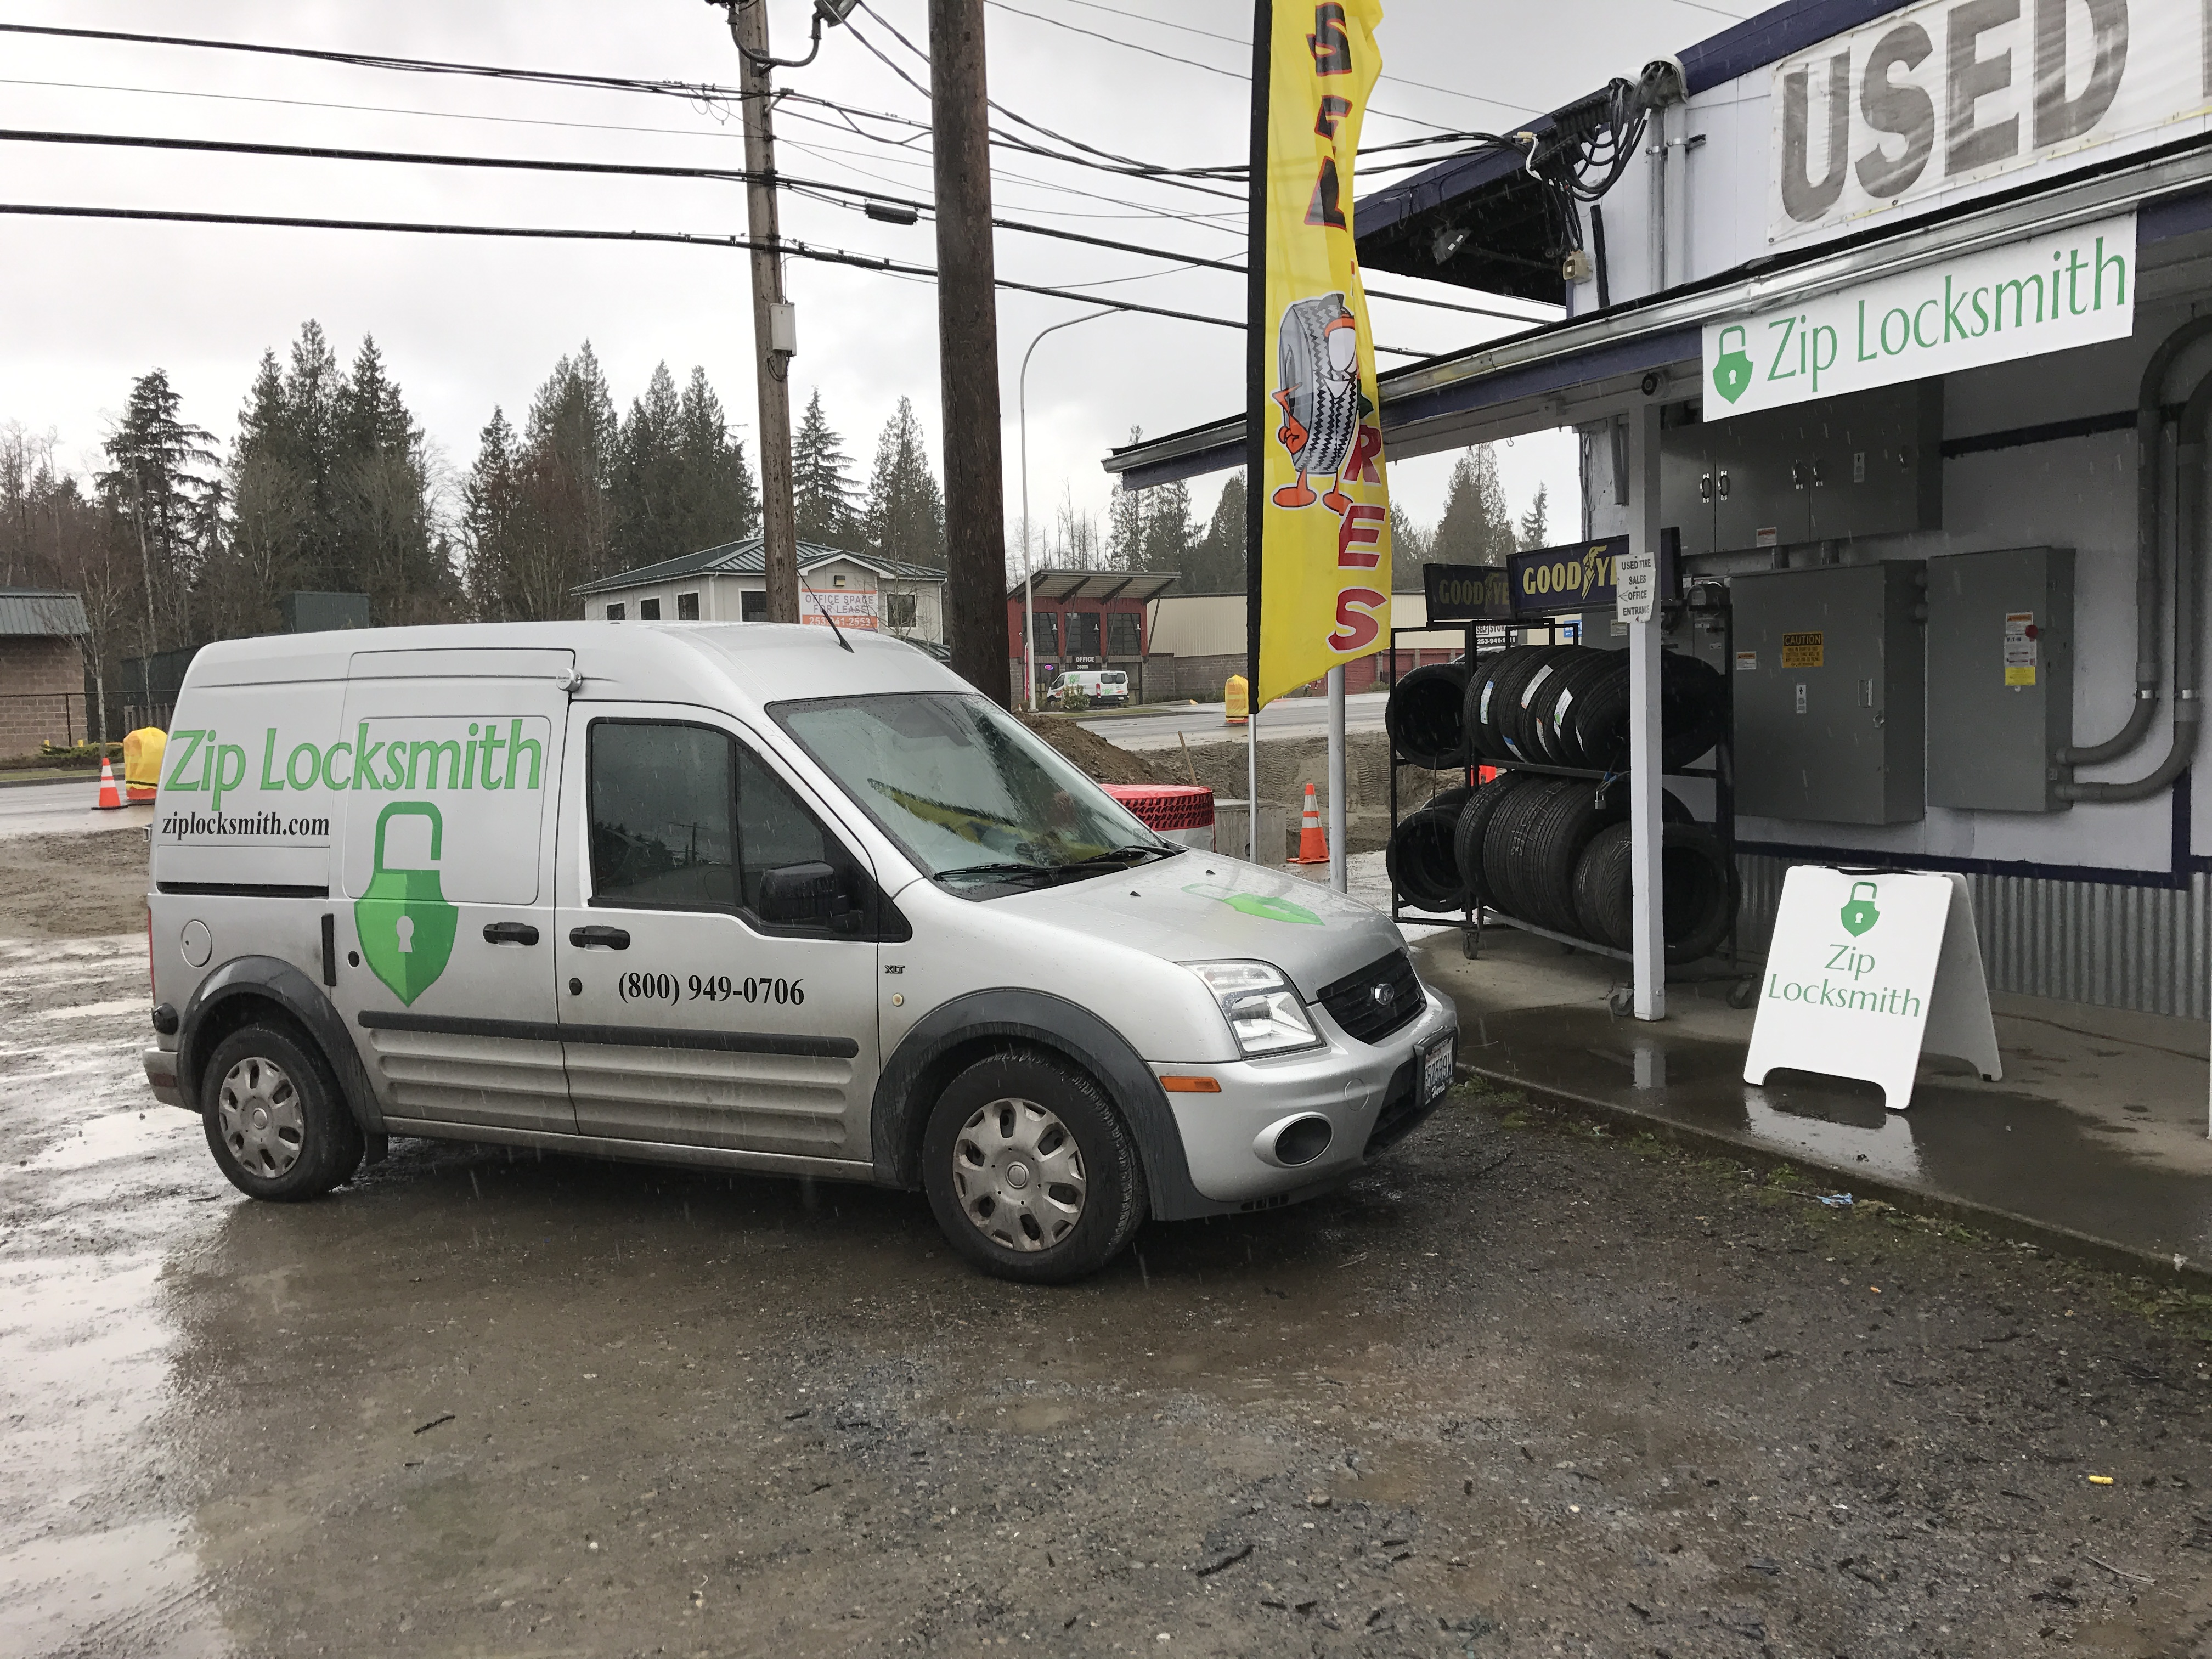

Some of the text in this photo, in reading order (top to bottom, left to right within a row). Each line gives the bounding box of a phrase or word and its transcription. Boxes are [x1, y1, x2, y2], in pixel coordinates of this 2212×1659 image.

[1782, 0, 2129, 222] USED
[1767, 236, 2126, 392] Zip Locksmith
[1621, 559, 1651, 571] USED TIRE
[1629, 574, 1646, 585] SALES
[805, 594, 873, 604] OFFICE SPACE
[1628, 590, 1647, 600] OFFICE
[814, 605, 867, 614] FOR LEASE
[1785, 635, 1821, 645] CAUTION
[165, 719, 542, 811] Zip Locksmith
[162, 812, 329, 840] ziplocksmith.com
[884, 964, 905, 974] XLT
[1825, 944, 1875, 980] Zip
[619, 972, 804, 1006] (800) 949-0706
[1768, 973, 1920, 1017] Locksmith
